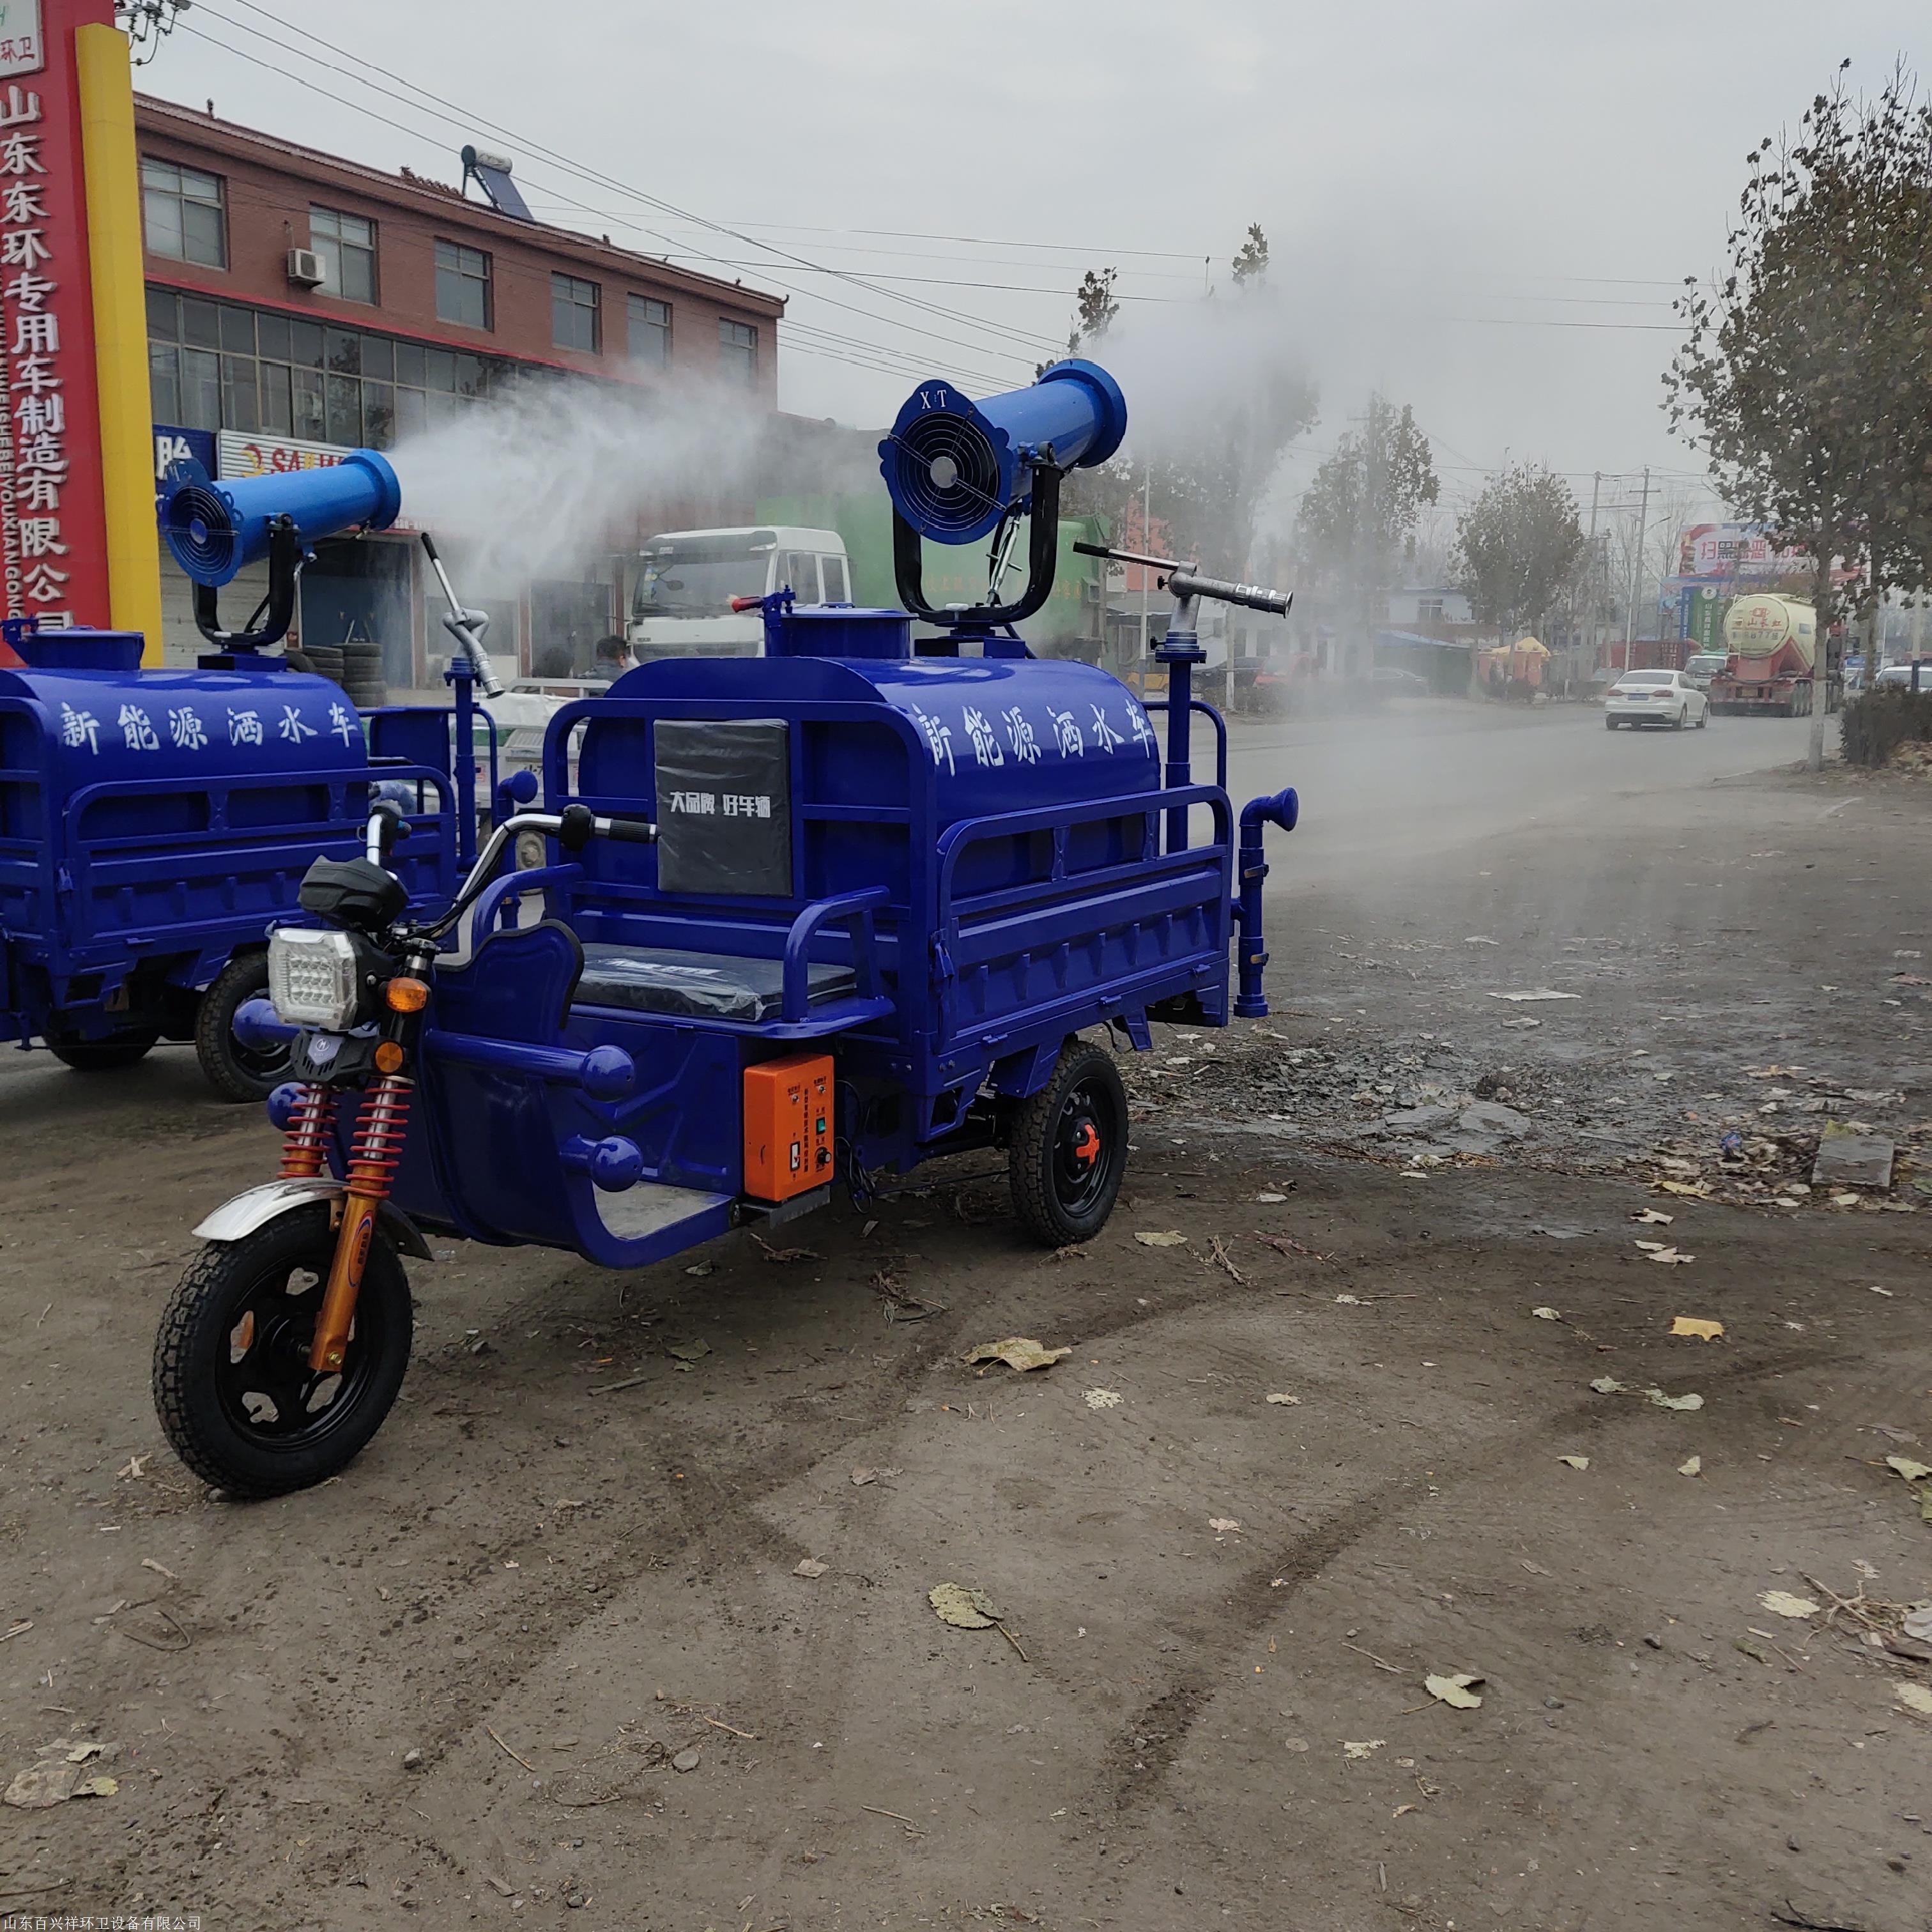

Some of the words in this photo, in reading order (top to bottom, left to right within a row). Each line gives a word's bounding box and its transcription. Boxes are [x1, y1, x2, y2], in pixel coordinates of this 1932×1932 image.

[0, 85, 74, 631] 山东东环专用车制造有限公司
[62, 702, 358, 755] 新能源洒水车
[912, 699, 1153, 777] 新能源洒水车
[670, 791, 715, 815] 大品牌
